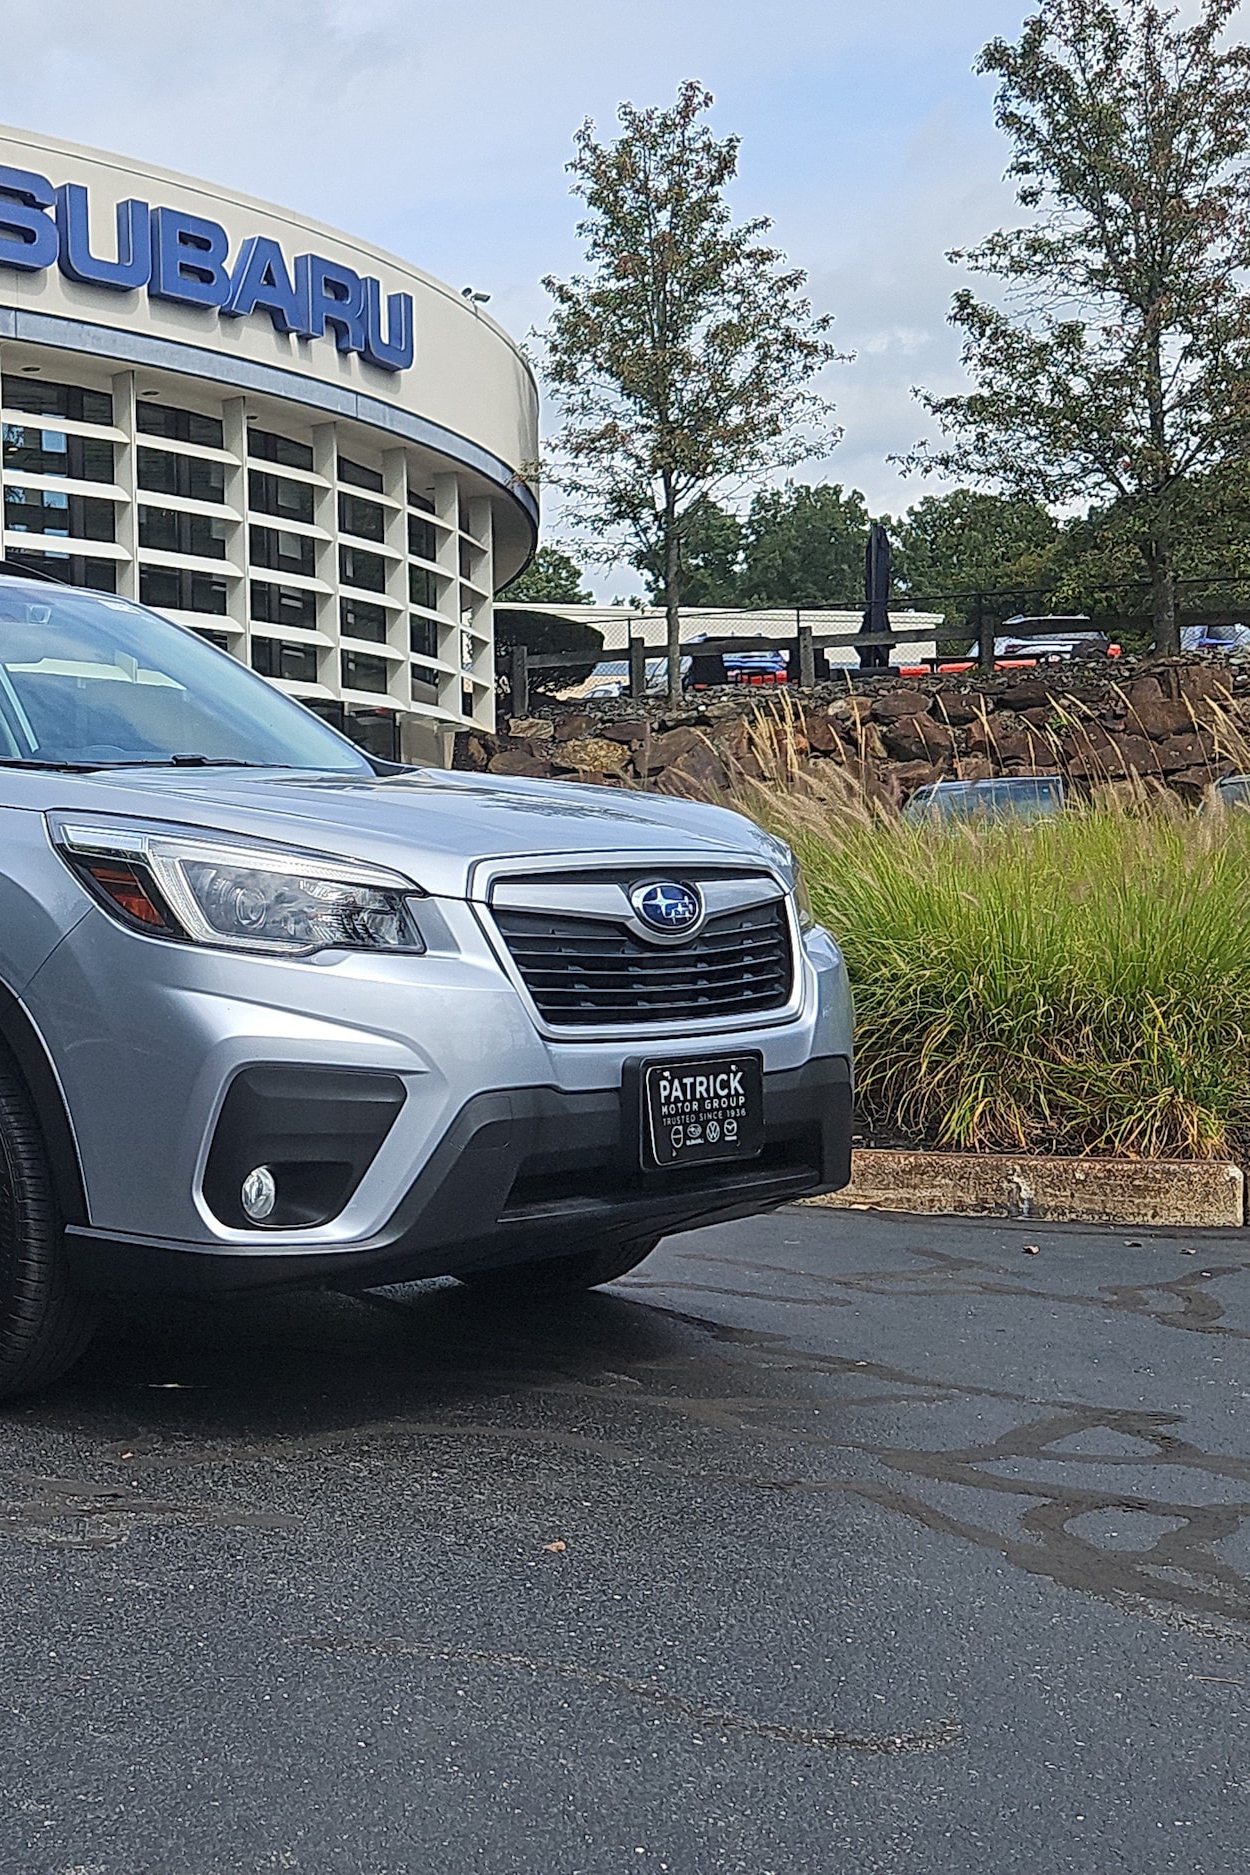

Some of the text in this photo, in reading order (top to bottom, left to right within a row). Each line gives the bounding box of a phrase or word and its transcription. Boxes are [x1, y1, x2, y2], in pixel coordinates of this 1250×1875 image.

[659, 1071, 745, 1103] PATRICK
[661, 1096, 746, 1116] MOTOR GROUP
[662, 1107, 747, 1126] TRUSTED SINCE 1936
